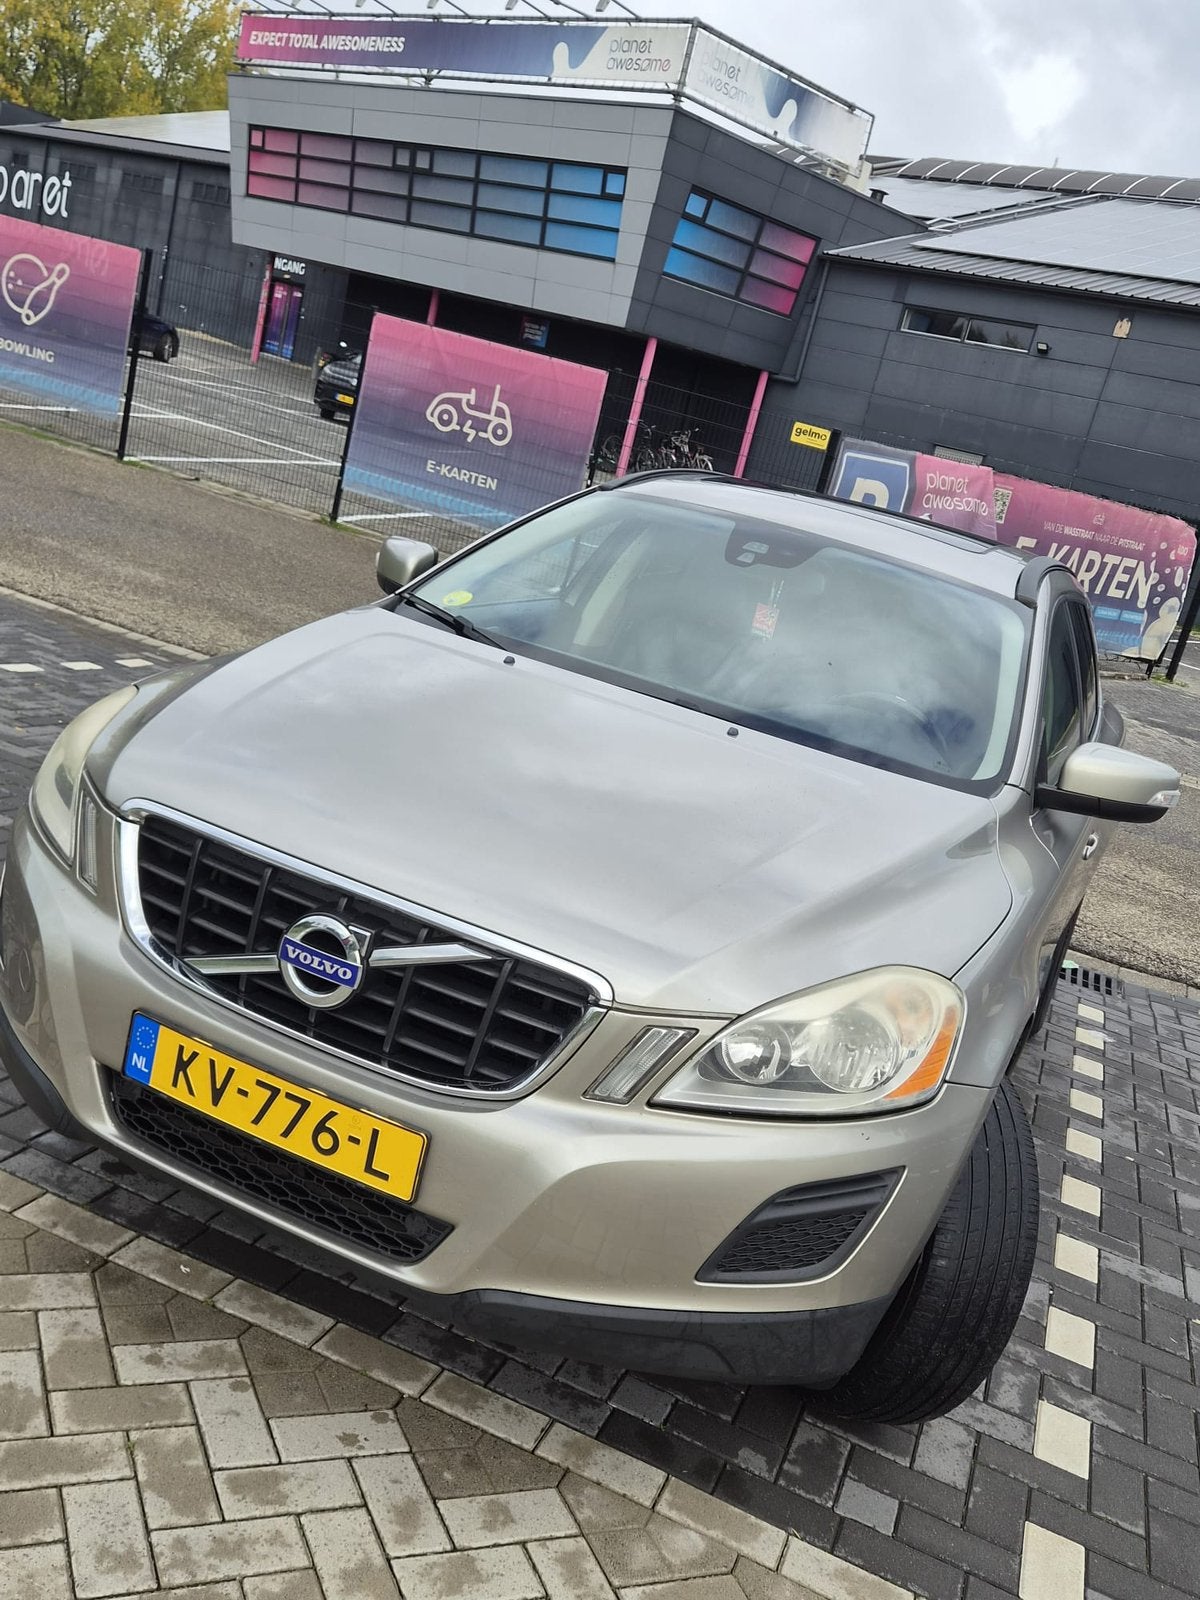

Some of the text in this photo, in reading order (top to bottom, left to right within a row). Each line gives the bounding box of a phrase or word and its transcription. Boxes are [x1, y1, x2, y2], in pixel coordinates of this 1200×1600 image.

[250, 31, 405, 52] EXPECT TOTAL AWESOMENESS
[609, 37, 652, 54] planet
[702, 49, 741, 82] planet
[795, 427, 827, 441] gelmo
[426, 460, 498, 491] E-KARTEN
[926, 471, 968, 494] planet
[1055, 523, 1064, 533] DE
[1064, 526, 1095, 539] WASSTRAAT
[285, 943, 352, 980] VOLVO
[132, 1044, 390, 1182] NL KV-776-L
